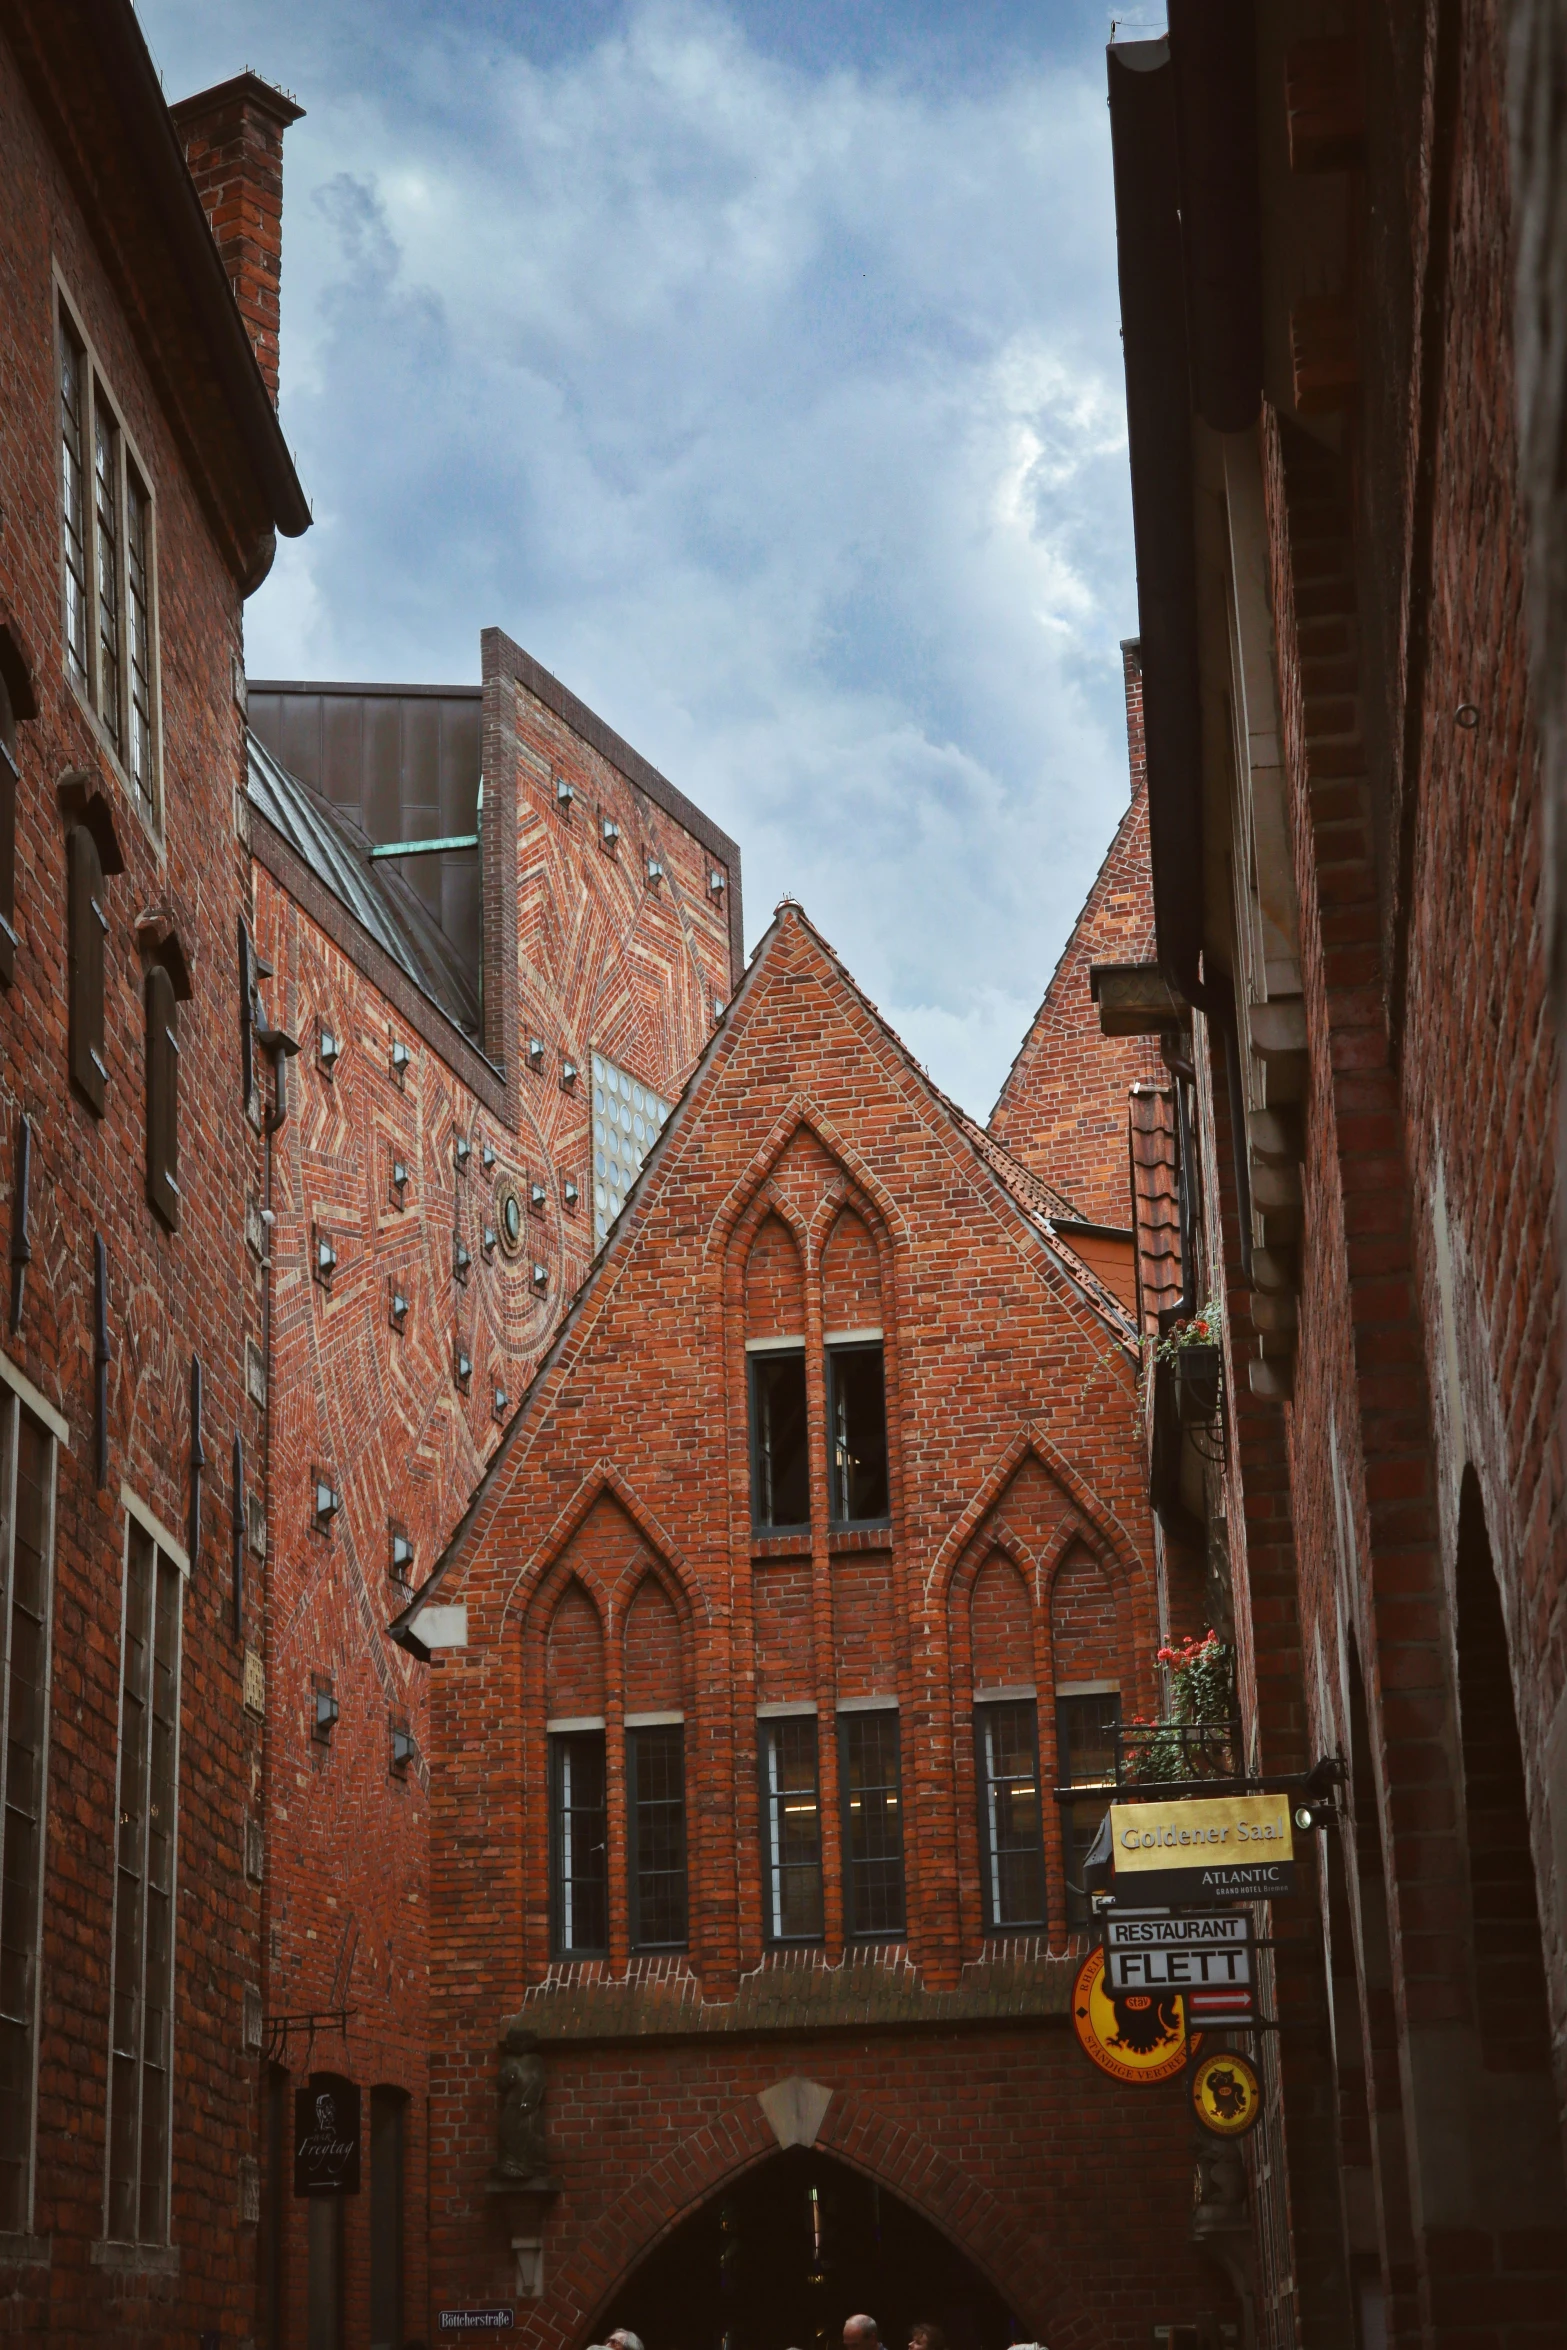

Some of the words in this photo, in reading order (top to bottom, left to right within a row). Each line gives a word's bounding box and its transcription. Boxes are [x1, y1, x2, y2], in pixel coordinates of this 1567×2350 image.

[1120, 1824, 1230, 1850] Goldener
[1236, 1816, 1284, 1842] Saal
[1201, 1866, 1280, 1885] ATLANTIC
[1215, 1887, 1239, 1896] GRAND
[1240, 1885, 1262, 1894] HOTEL
[1263, 1884, 1289, 1892] Bremen
[1115, 1919, 1239, 1942] RESTAURANT
[1080, 1951, 1104, 1992] RHEIN
[1119, 1949, 1243, 1985] FLETT
[1128, 1997, 1149, 2008] stäv
[1084, 2034, 1134, 2080] STÄNDIGE
[297, 2137, 355, 2174] Freytag
[441, 2311, 510, 2328] Böttcherstraße
